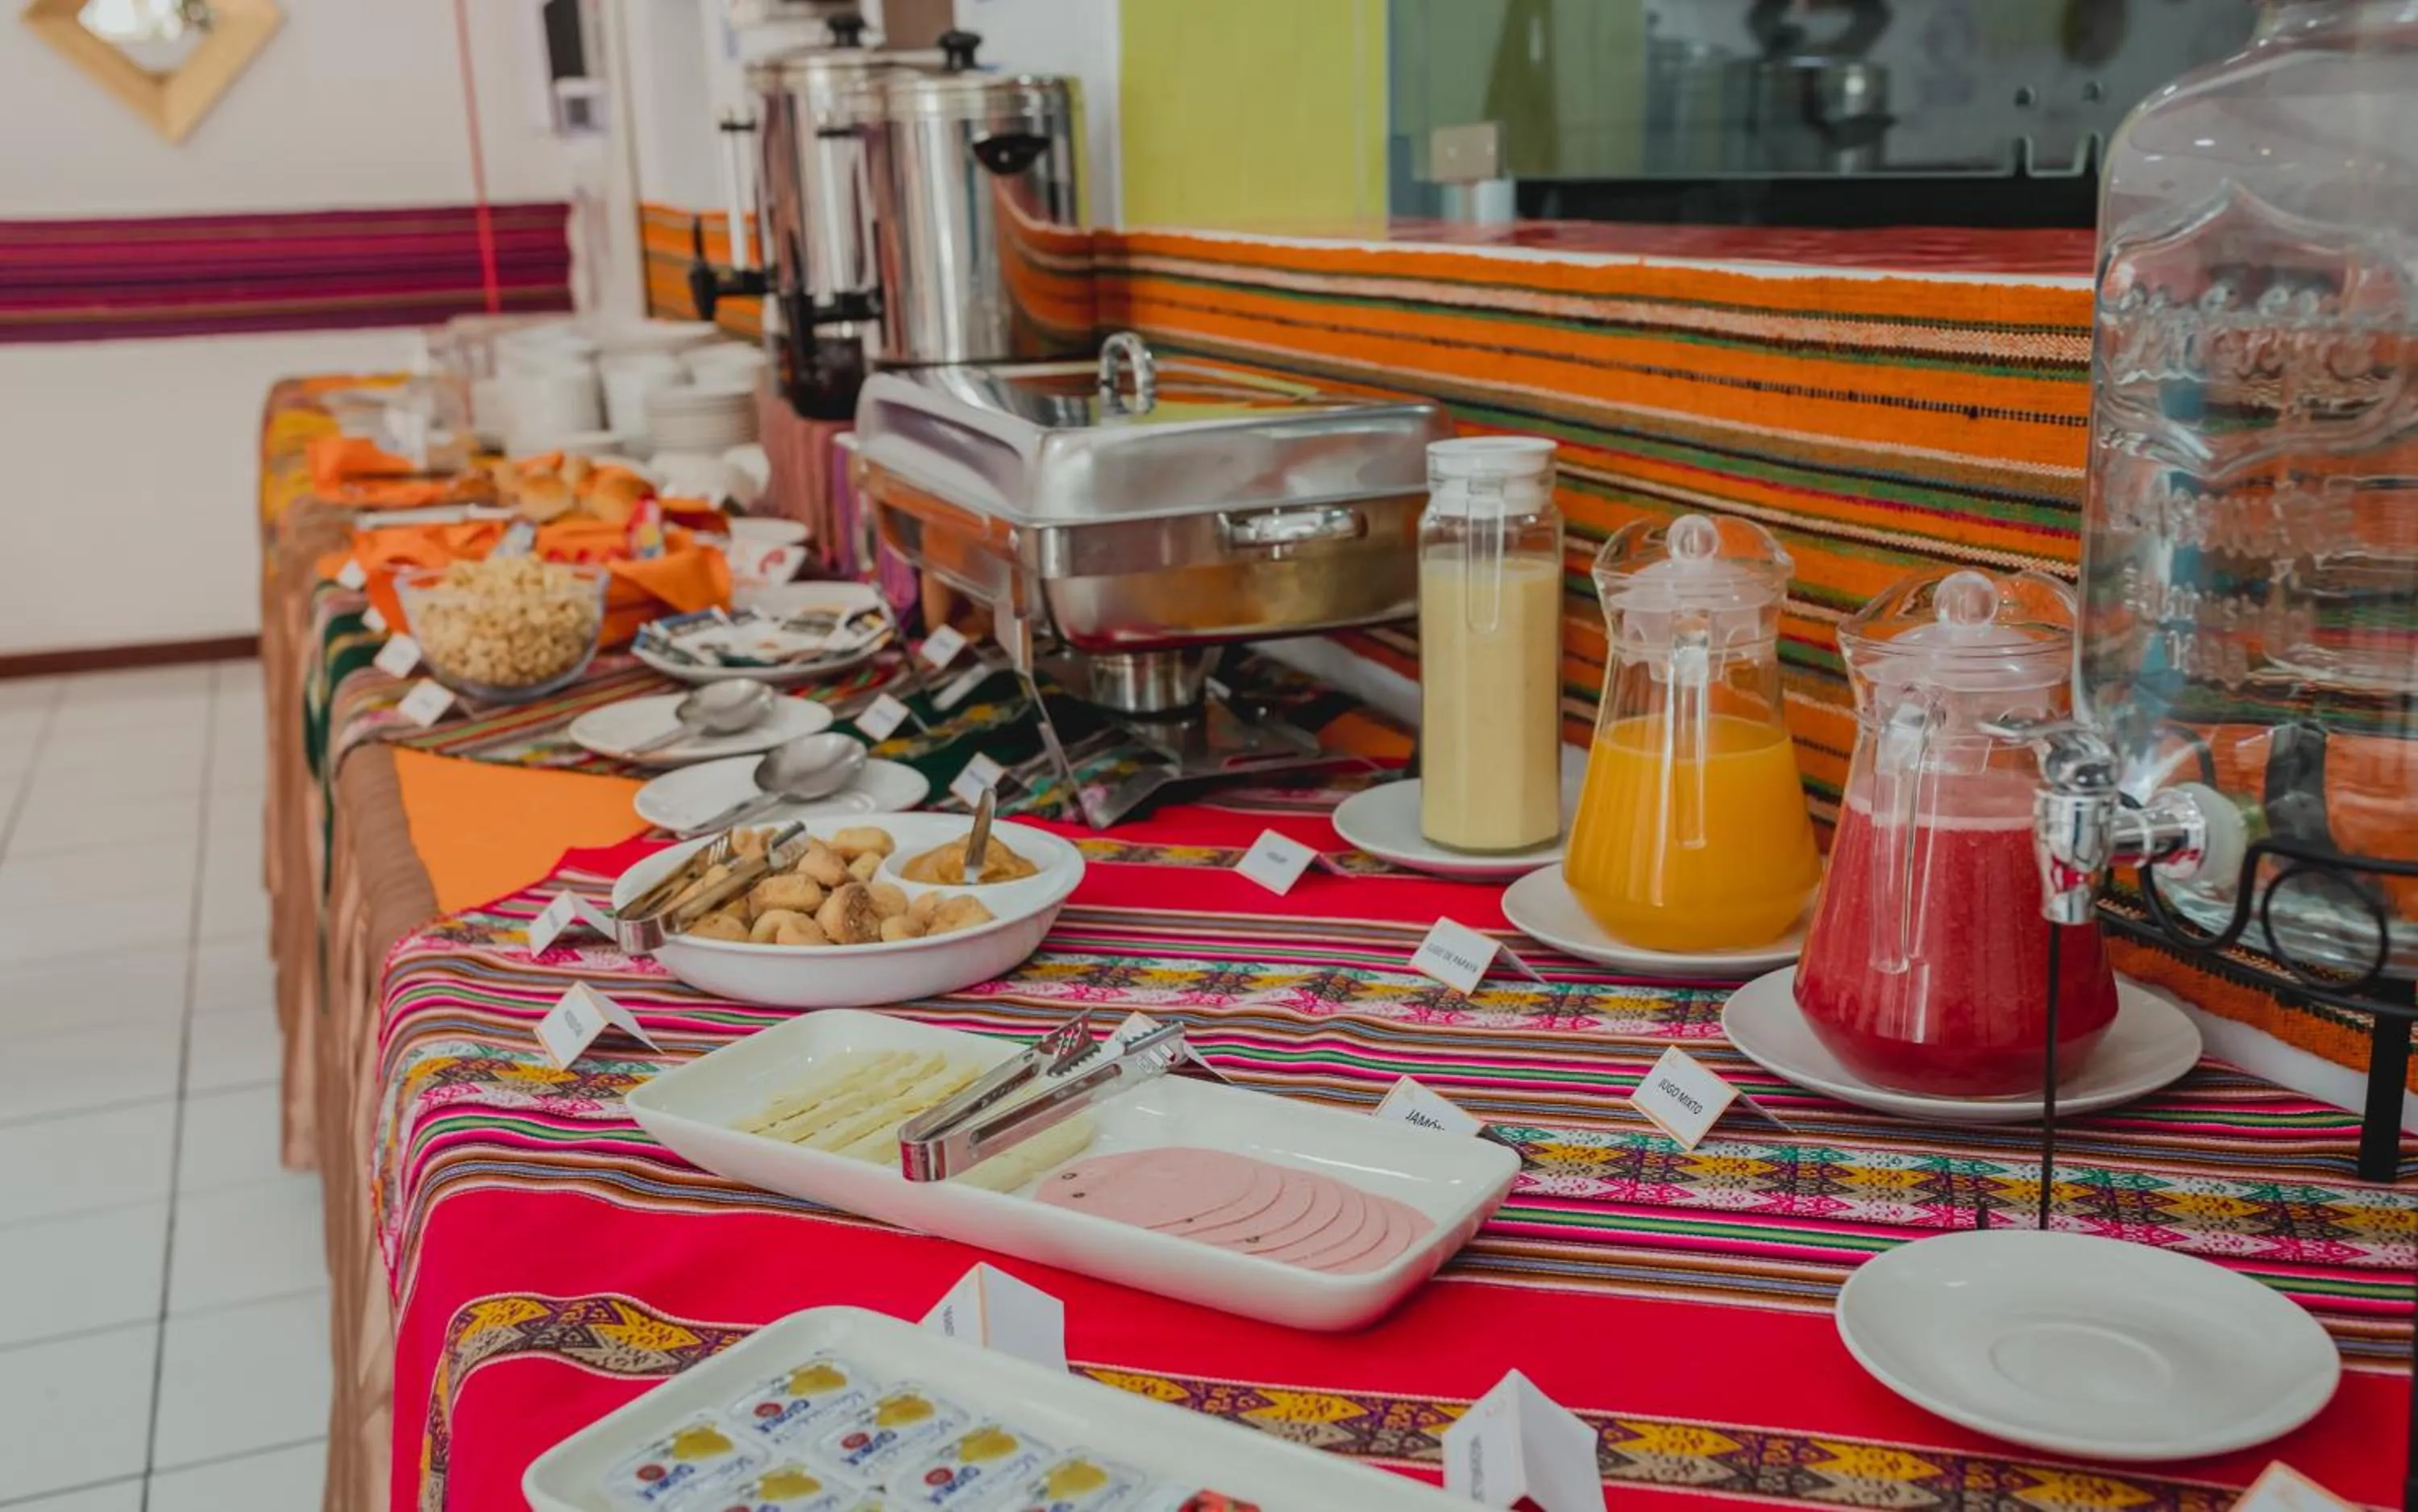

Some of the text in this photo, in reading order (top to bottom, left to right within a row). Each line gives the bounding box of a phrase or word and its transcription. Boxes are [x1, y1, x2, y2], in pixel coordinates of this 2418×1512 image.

[1659, 1078, 1704, 1115] JUGO MIXTO
[1405, 1109, 1446, 1132] JAMÓ
